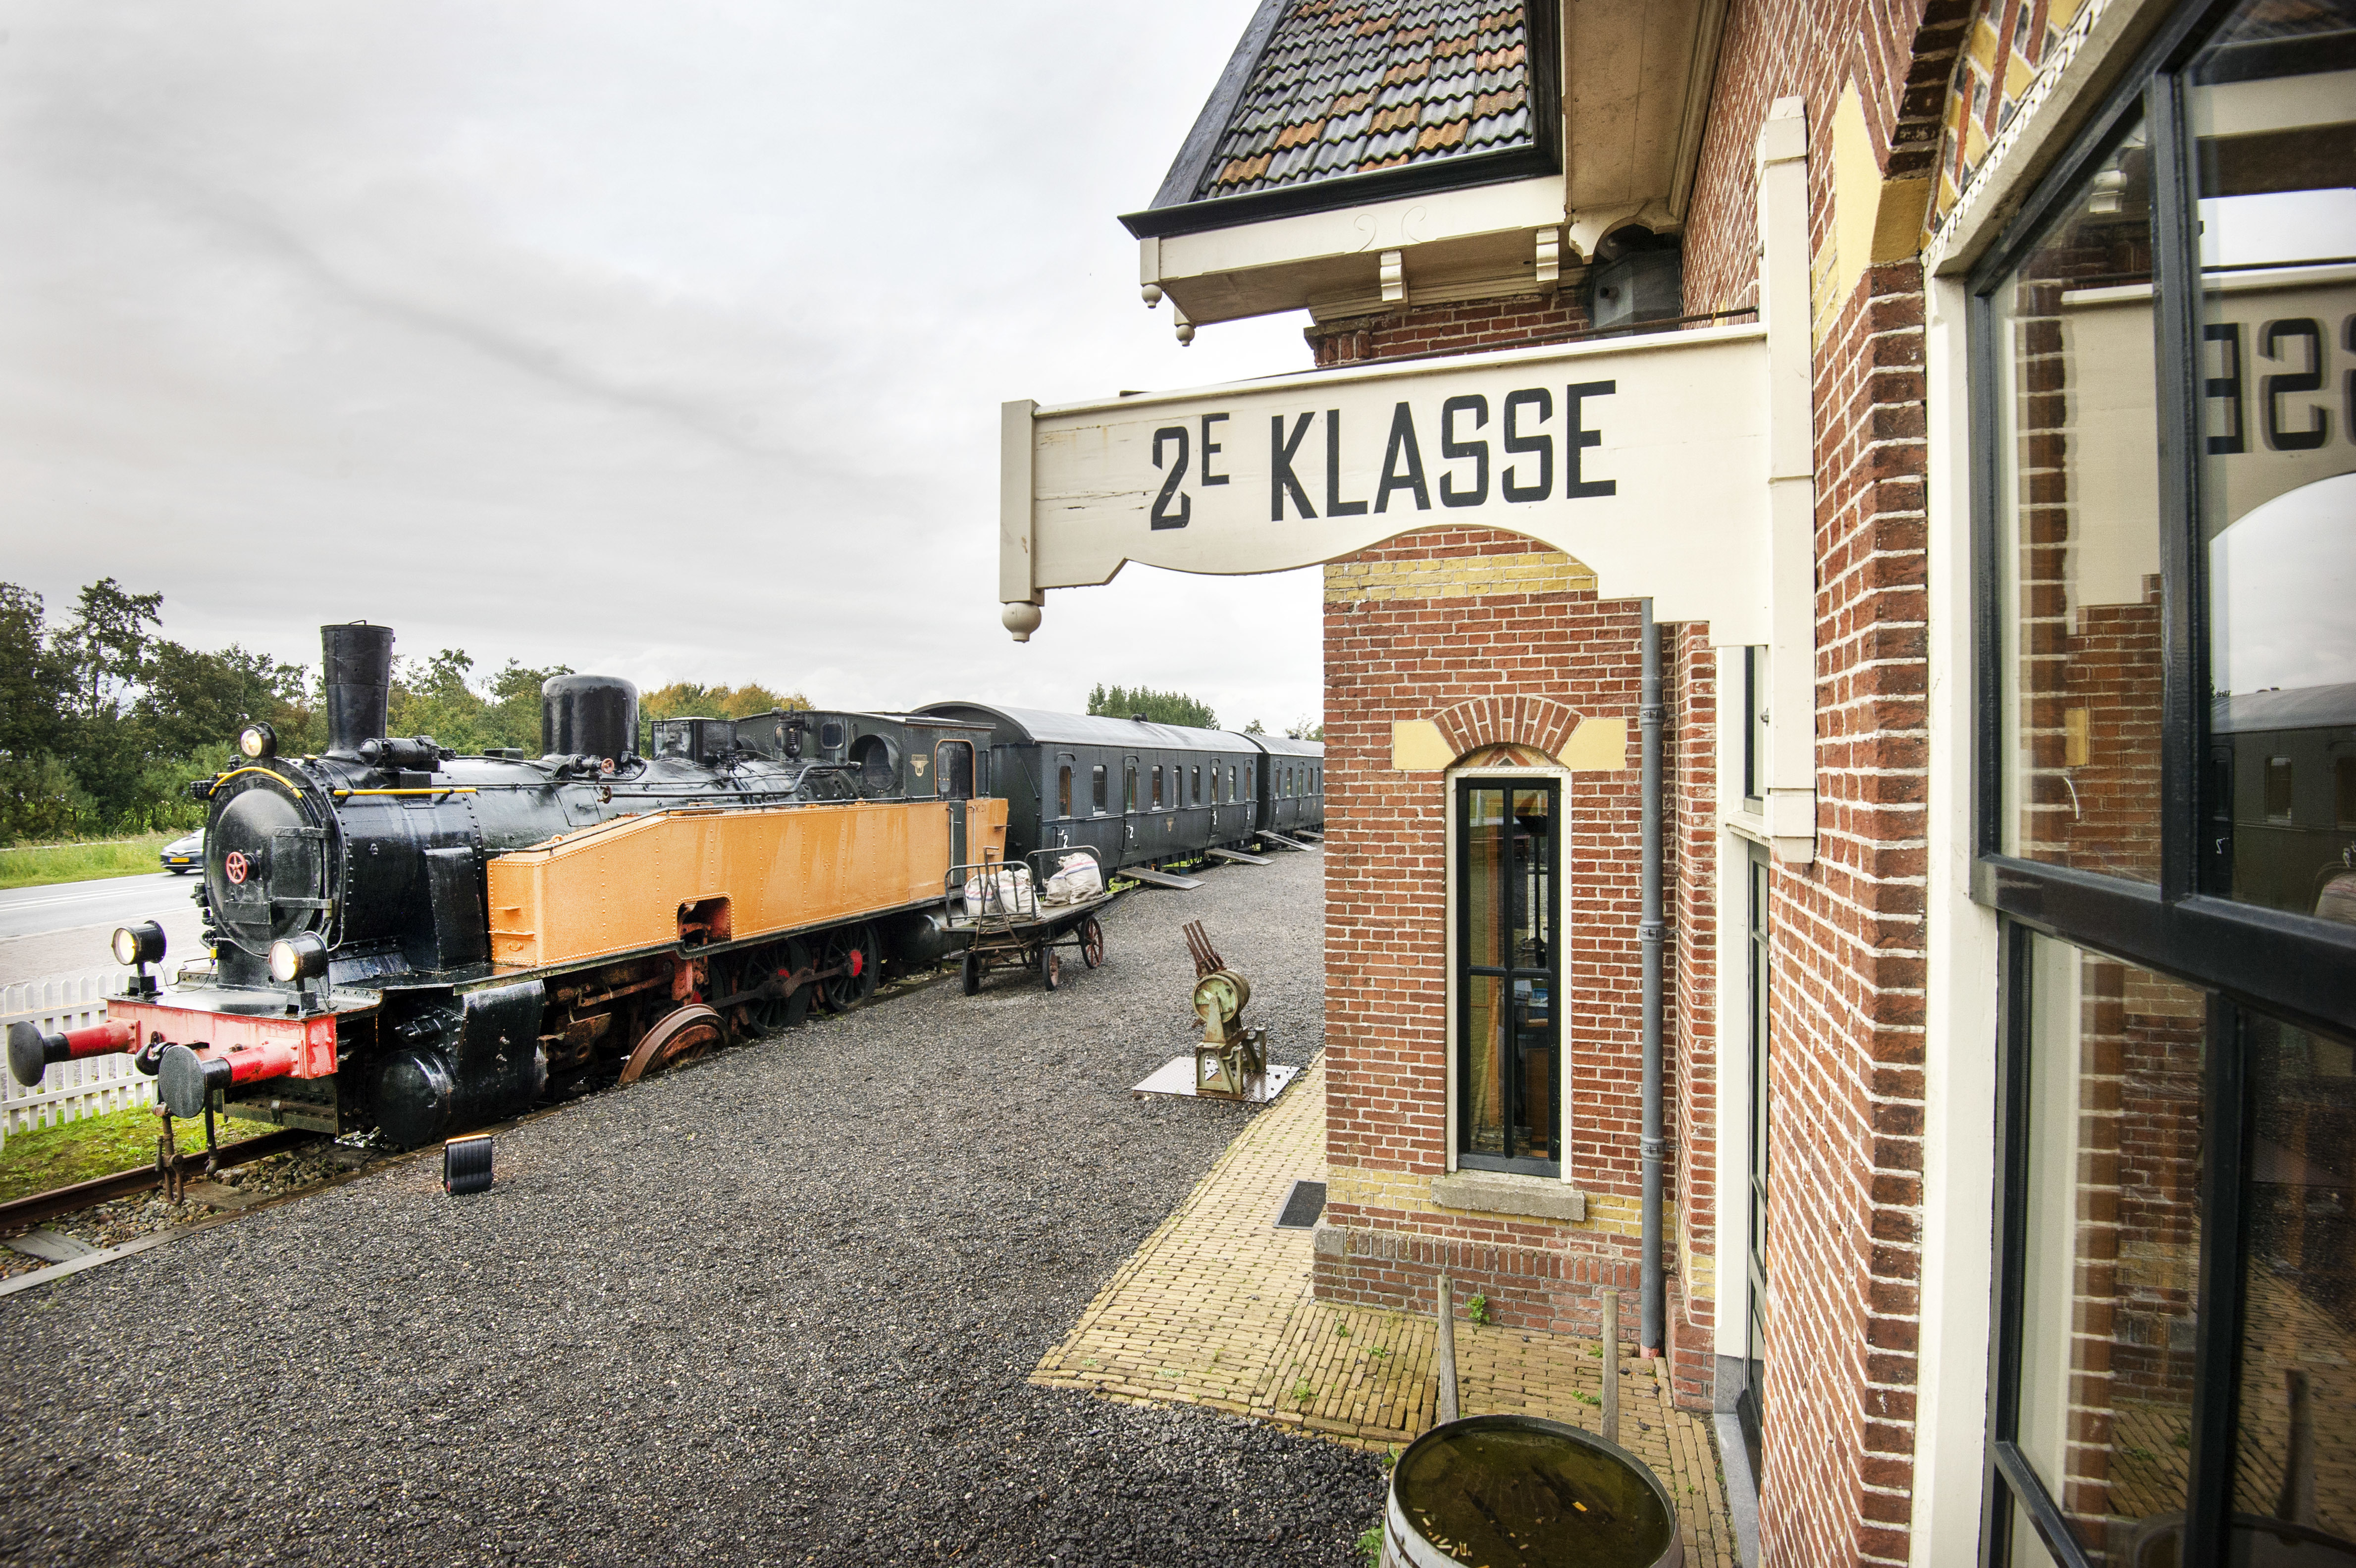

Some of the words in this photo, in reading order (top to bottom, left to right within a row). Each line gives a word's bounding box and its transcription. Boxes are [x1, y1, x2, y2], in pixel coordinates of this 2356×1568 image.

[1271, 379, 1616, 522] KLASSE
[1129, 826, 1134, 838] 2
[1063, 835, 1068, 848] 2
